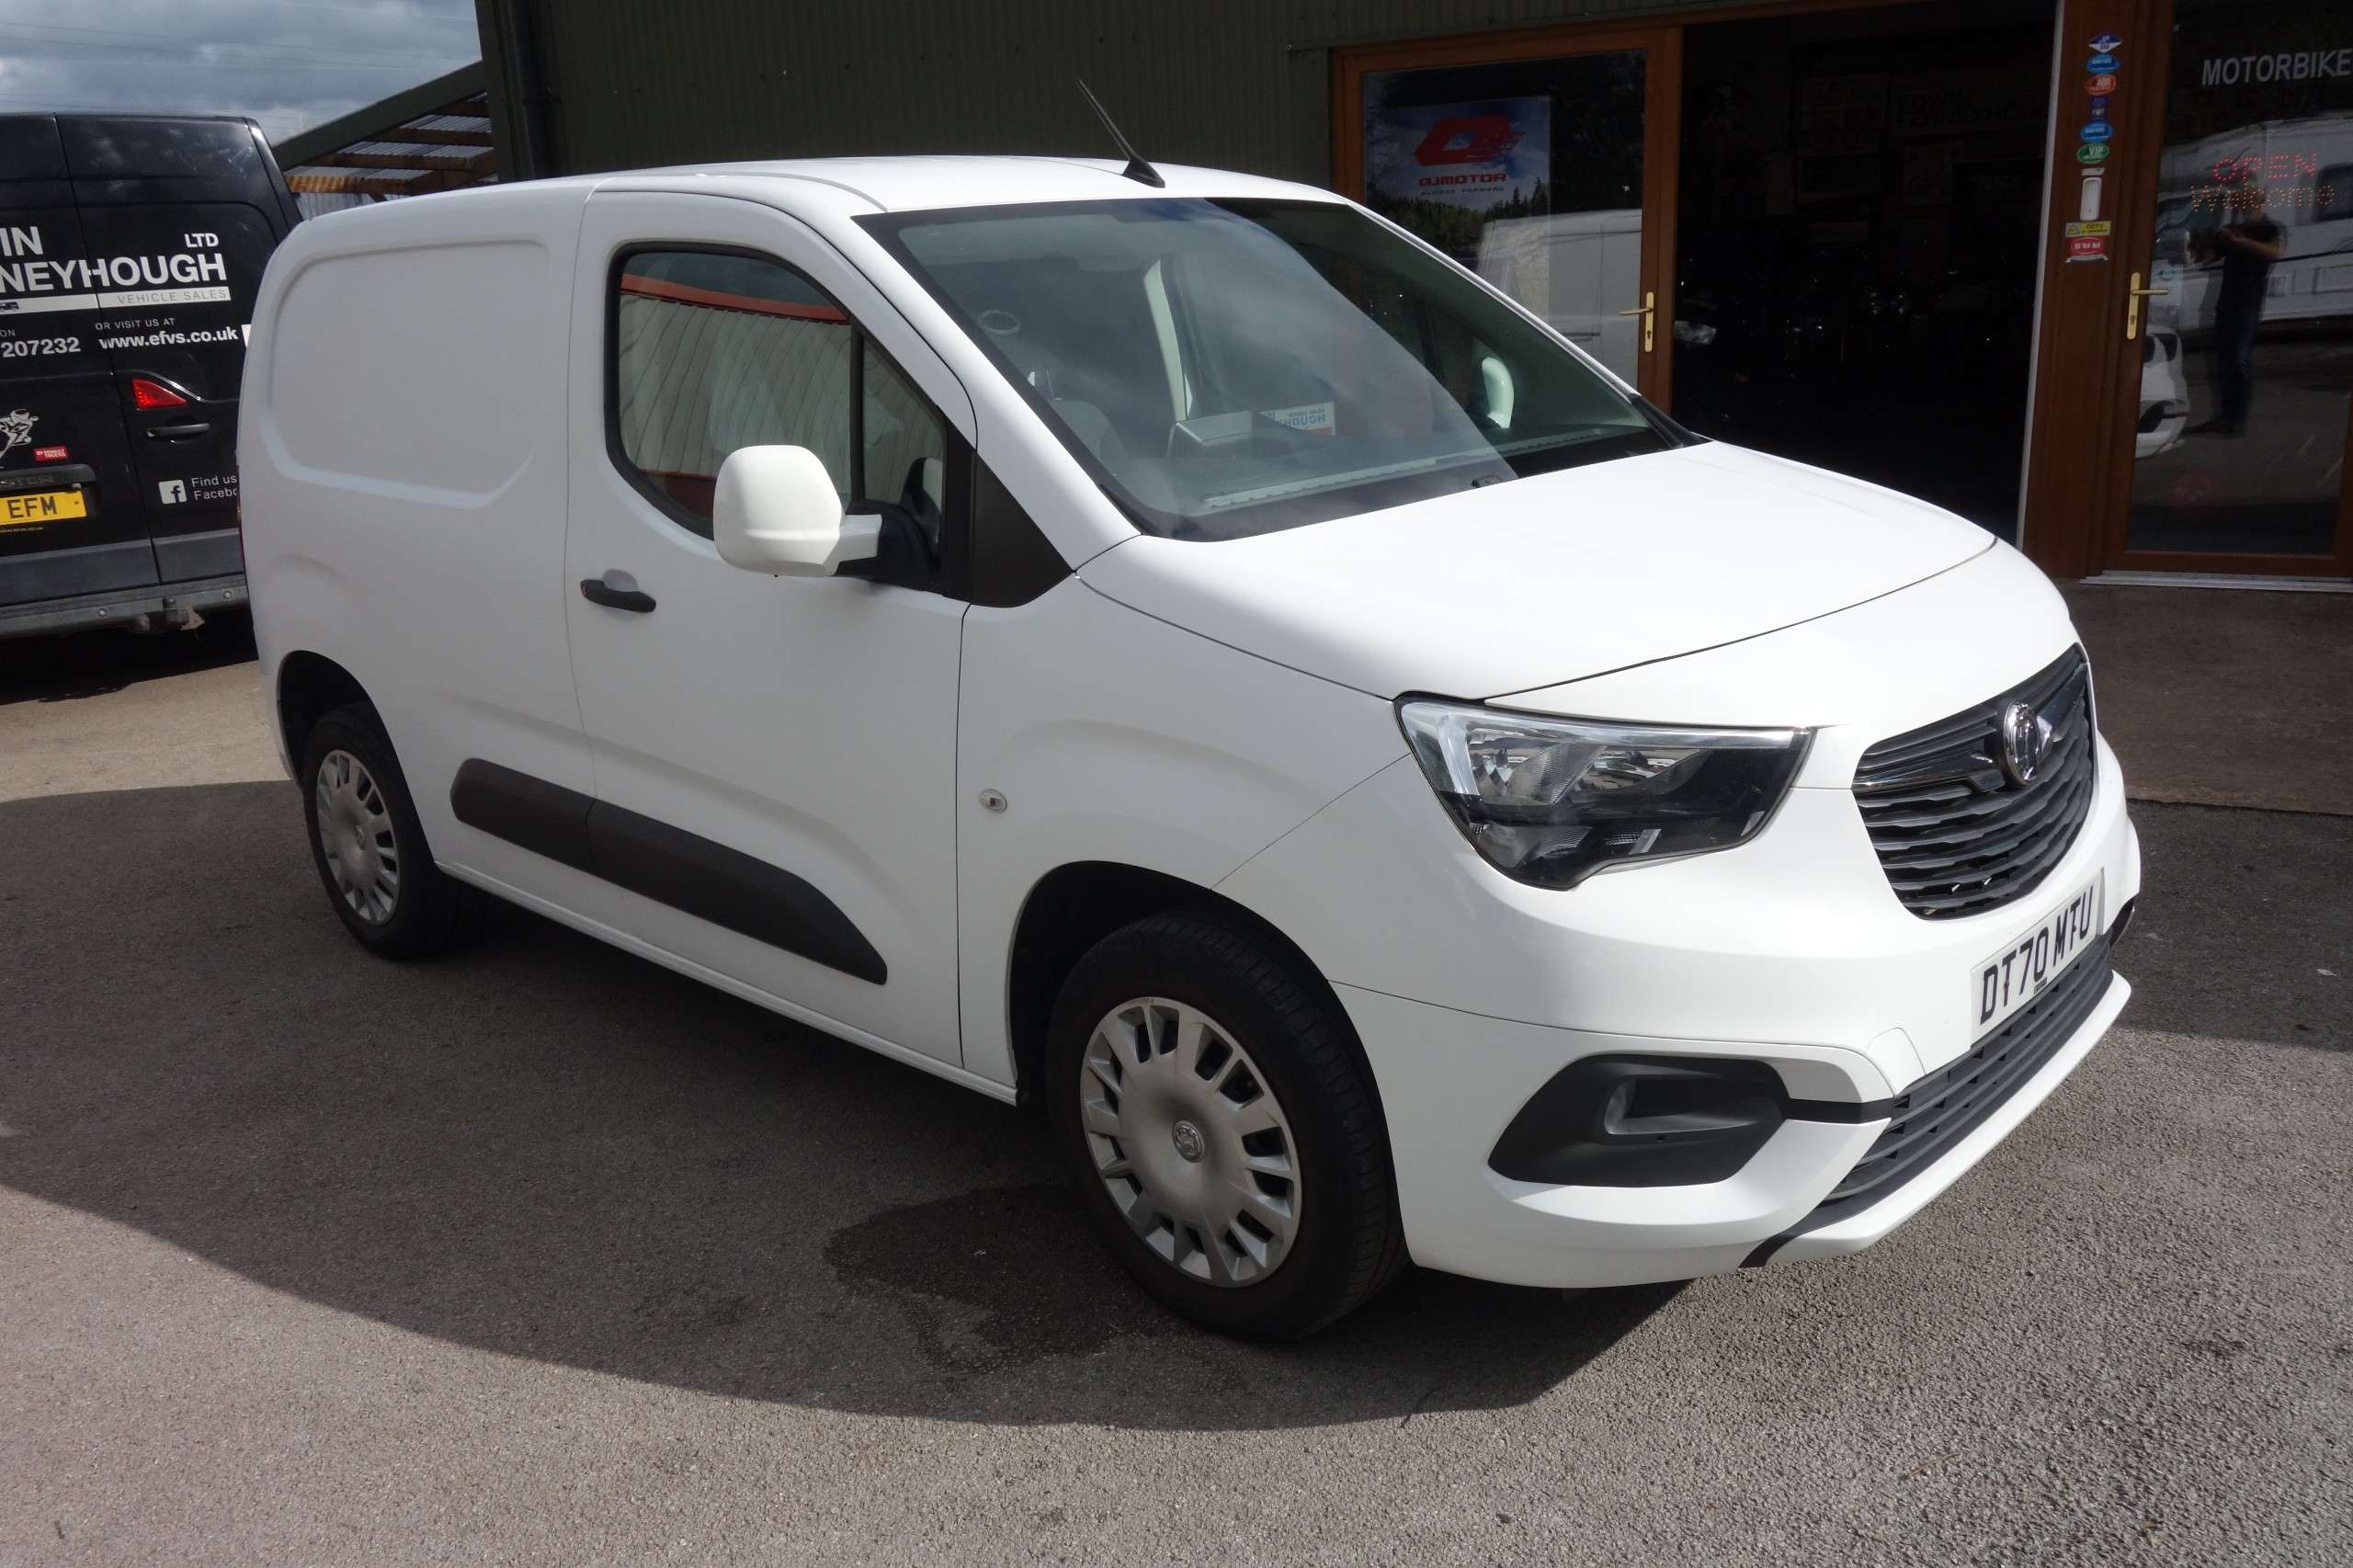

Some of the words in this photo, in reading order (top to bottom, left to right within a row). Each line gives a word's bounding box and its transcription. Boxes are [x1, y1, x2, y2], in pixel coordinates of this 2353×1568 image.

[2211, 149, 2317, 182] OPEN
[184, 233, 220, 249] LTD
[117, 292, 177, 304] VEHICLE
[184, 290, 227, 301] SALES
[95, 323, 111, 332] OR
[114, 320, 141, 330] VISIT
[145, 318, 160, 327] US
[163, 317, 176, 326] AT
[0, 336, 82, 358] 207232
[98, 326, 239, 349] www.efvs.co.uk
[191, 475, 220, 488] Find
[222, 475, 237, 483] us
[7, 495, 57, 519] EFM
[1980, 926, 2050, 1025] DT70
